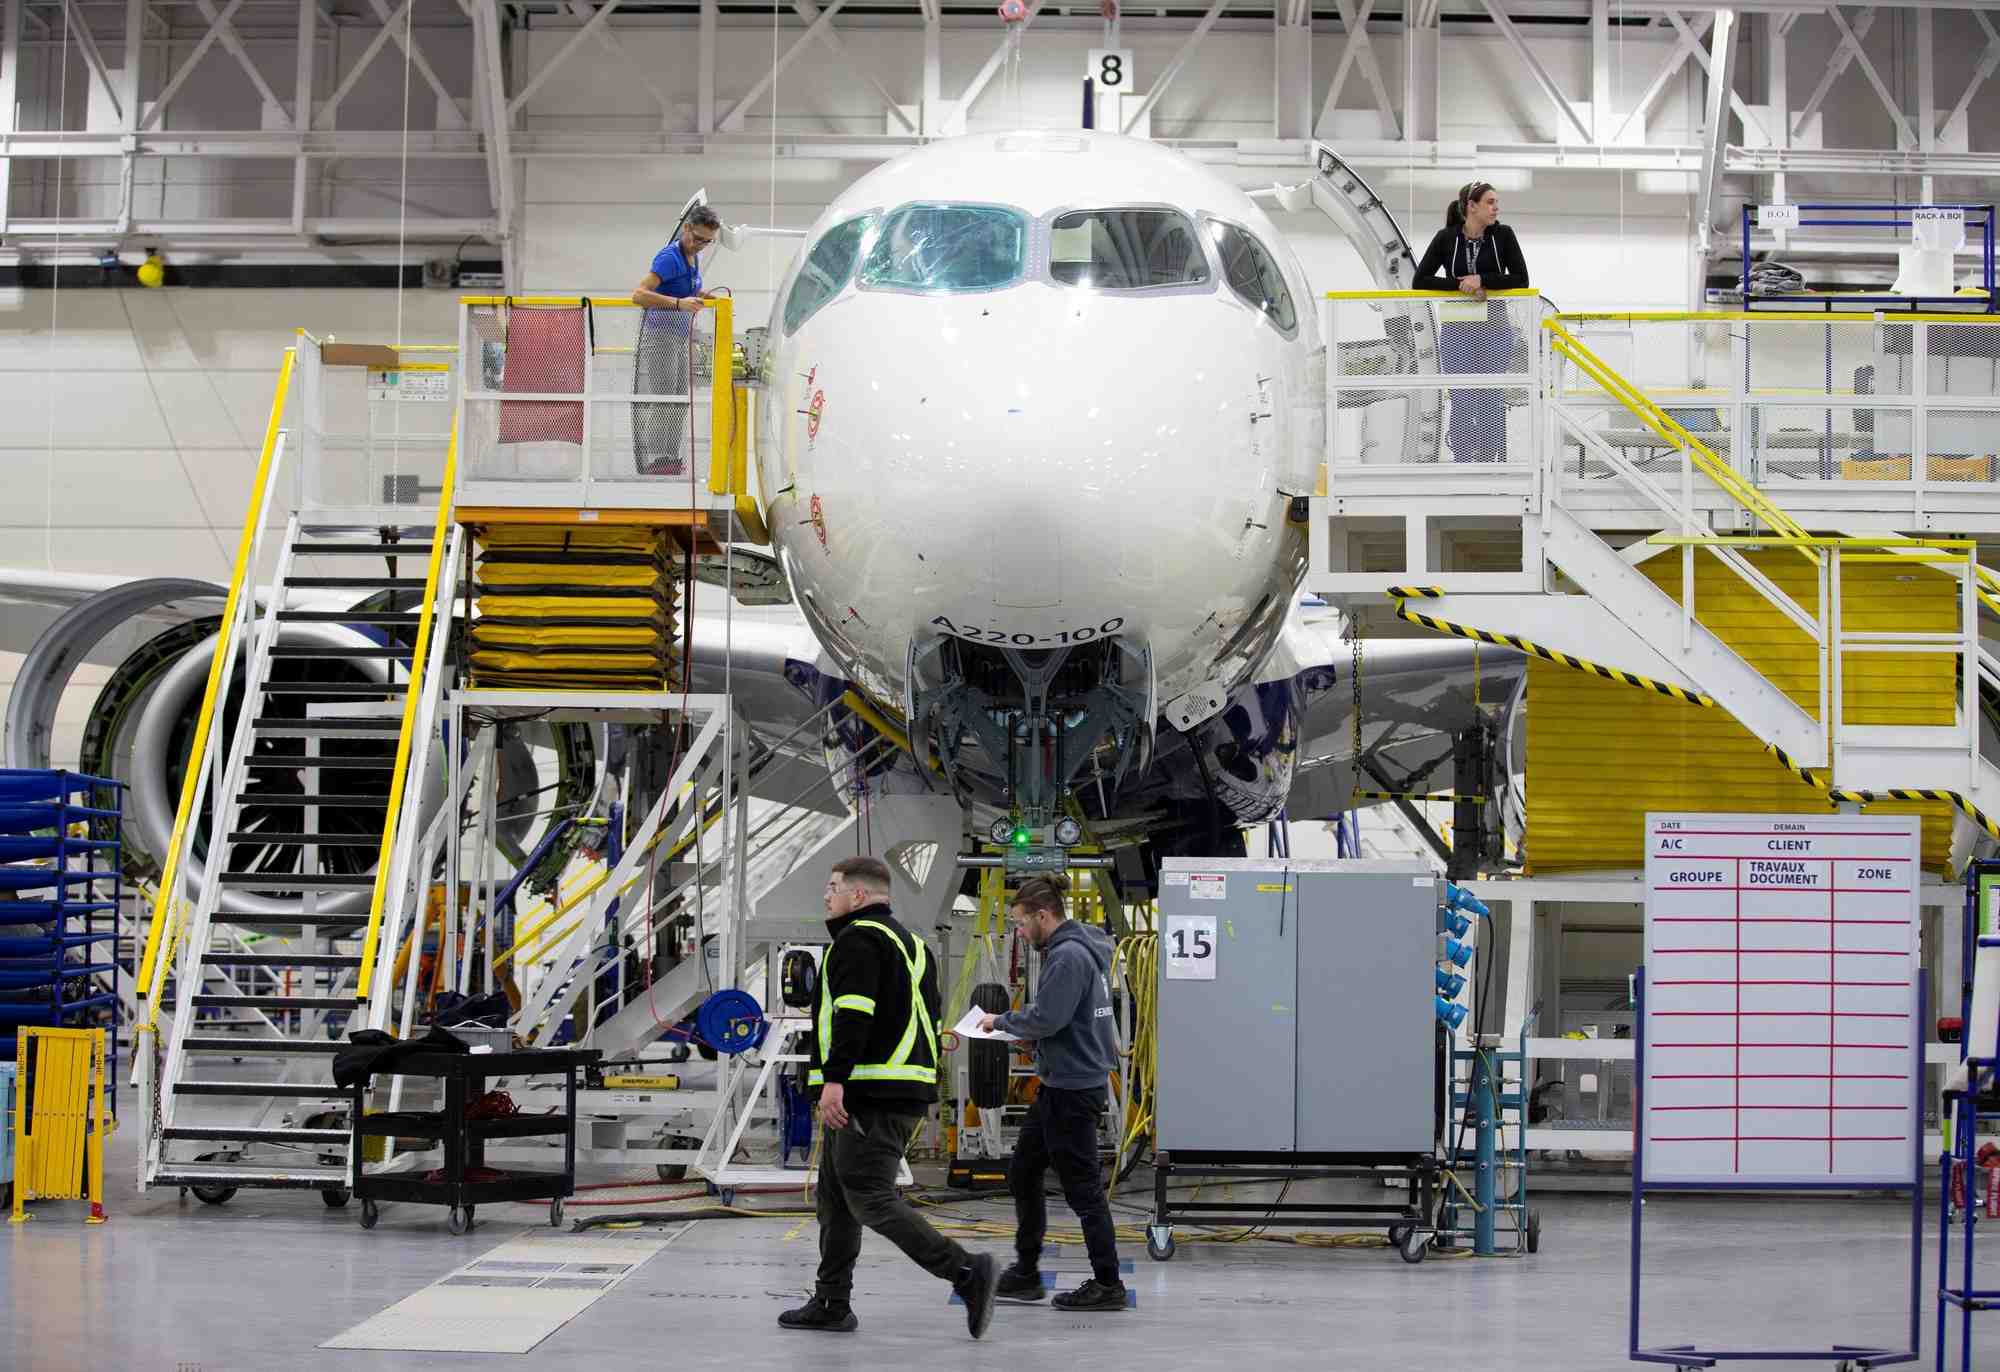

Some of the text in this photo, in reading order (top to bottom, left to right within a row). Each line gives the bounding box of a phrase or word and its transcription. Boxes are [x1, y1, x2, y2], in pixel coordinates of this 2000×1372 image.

[1101, 54, 1122, 86] 8
[931, 615, 1125, 645] A220-100
[1660, 821, 1681, 830] DATE
[1773, 823, 1806, 832] DEMAIN
[1660, 838, 1683, 850] A/C
[1767, 839, 1811, 851] CLIENT
[1750, 861, 1805, 873] TRAVAUX
[1669, 871, 1723, 883] GROUPE
[1750, 873, 1818, 885] DOCUMENT
[1857, 868, 1892, 880] ZONE
[1171, 929, 1212, 959] 15
